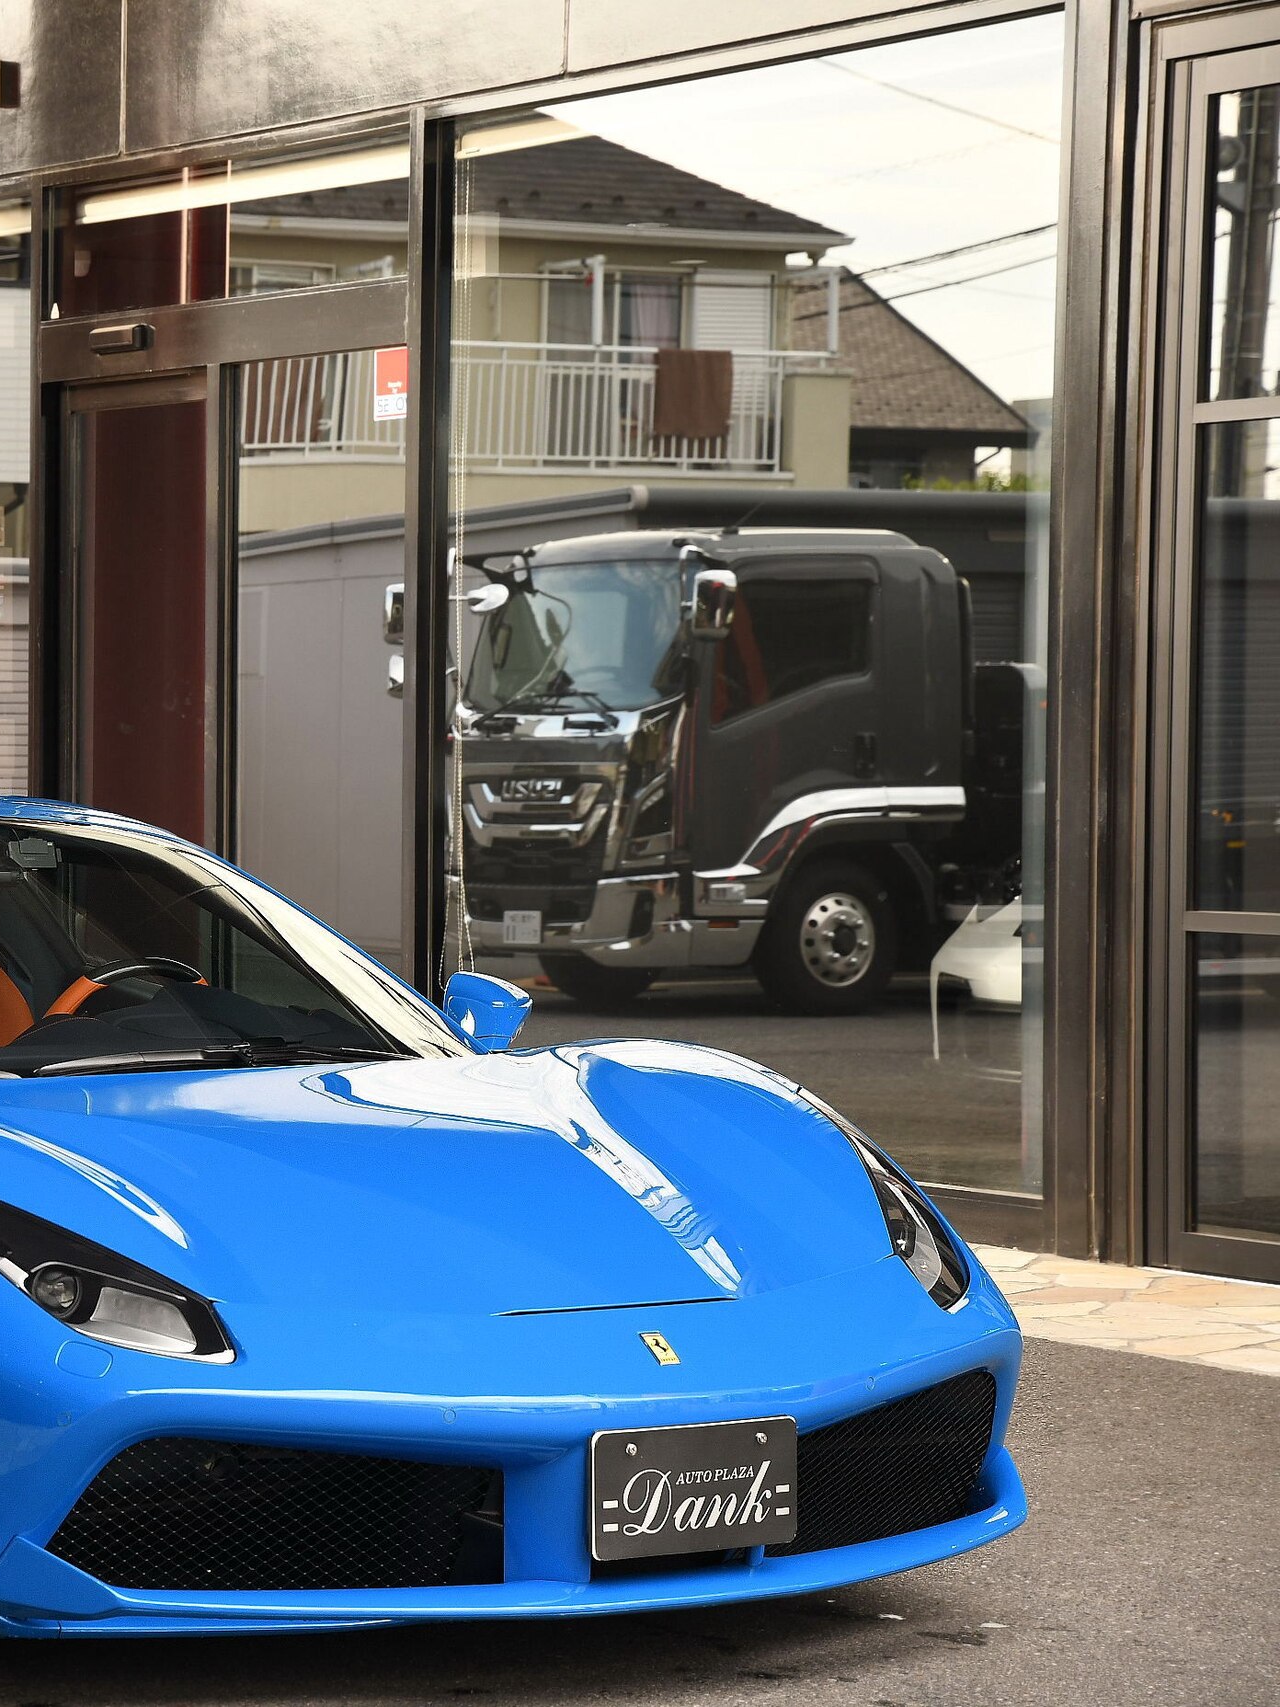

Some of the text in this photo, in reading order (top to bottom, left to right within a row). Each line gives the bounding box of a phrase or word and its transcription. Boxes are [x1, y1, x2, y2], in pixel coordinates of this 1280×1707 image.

[377, 396, 407, 413] SEO
[676, 1465, 755, 1485] AUTO PLAZA
[622, 1460, 772, 1536] Dank
